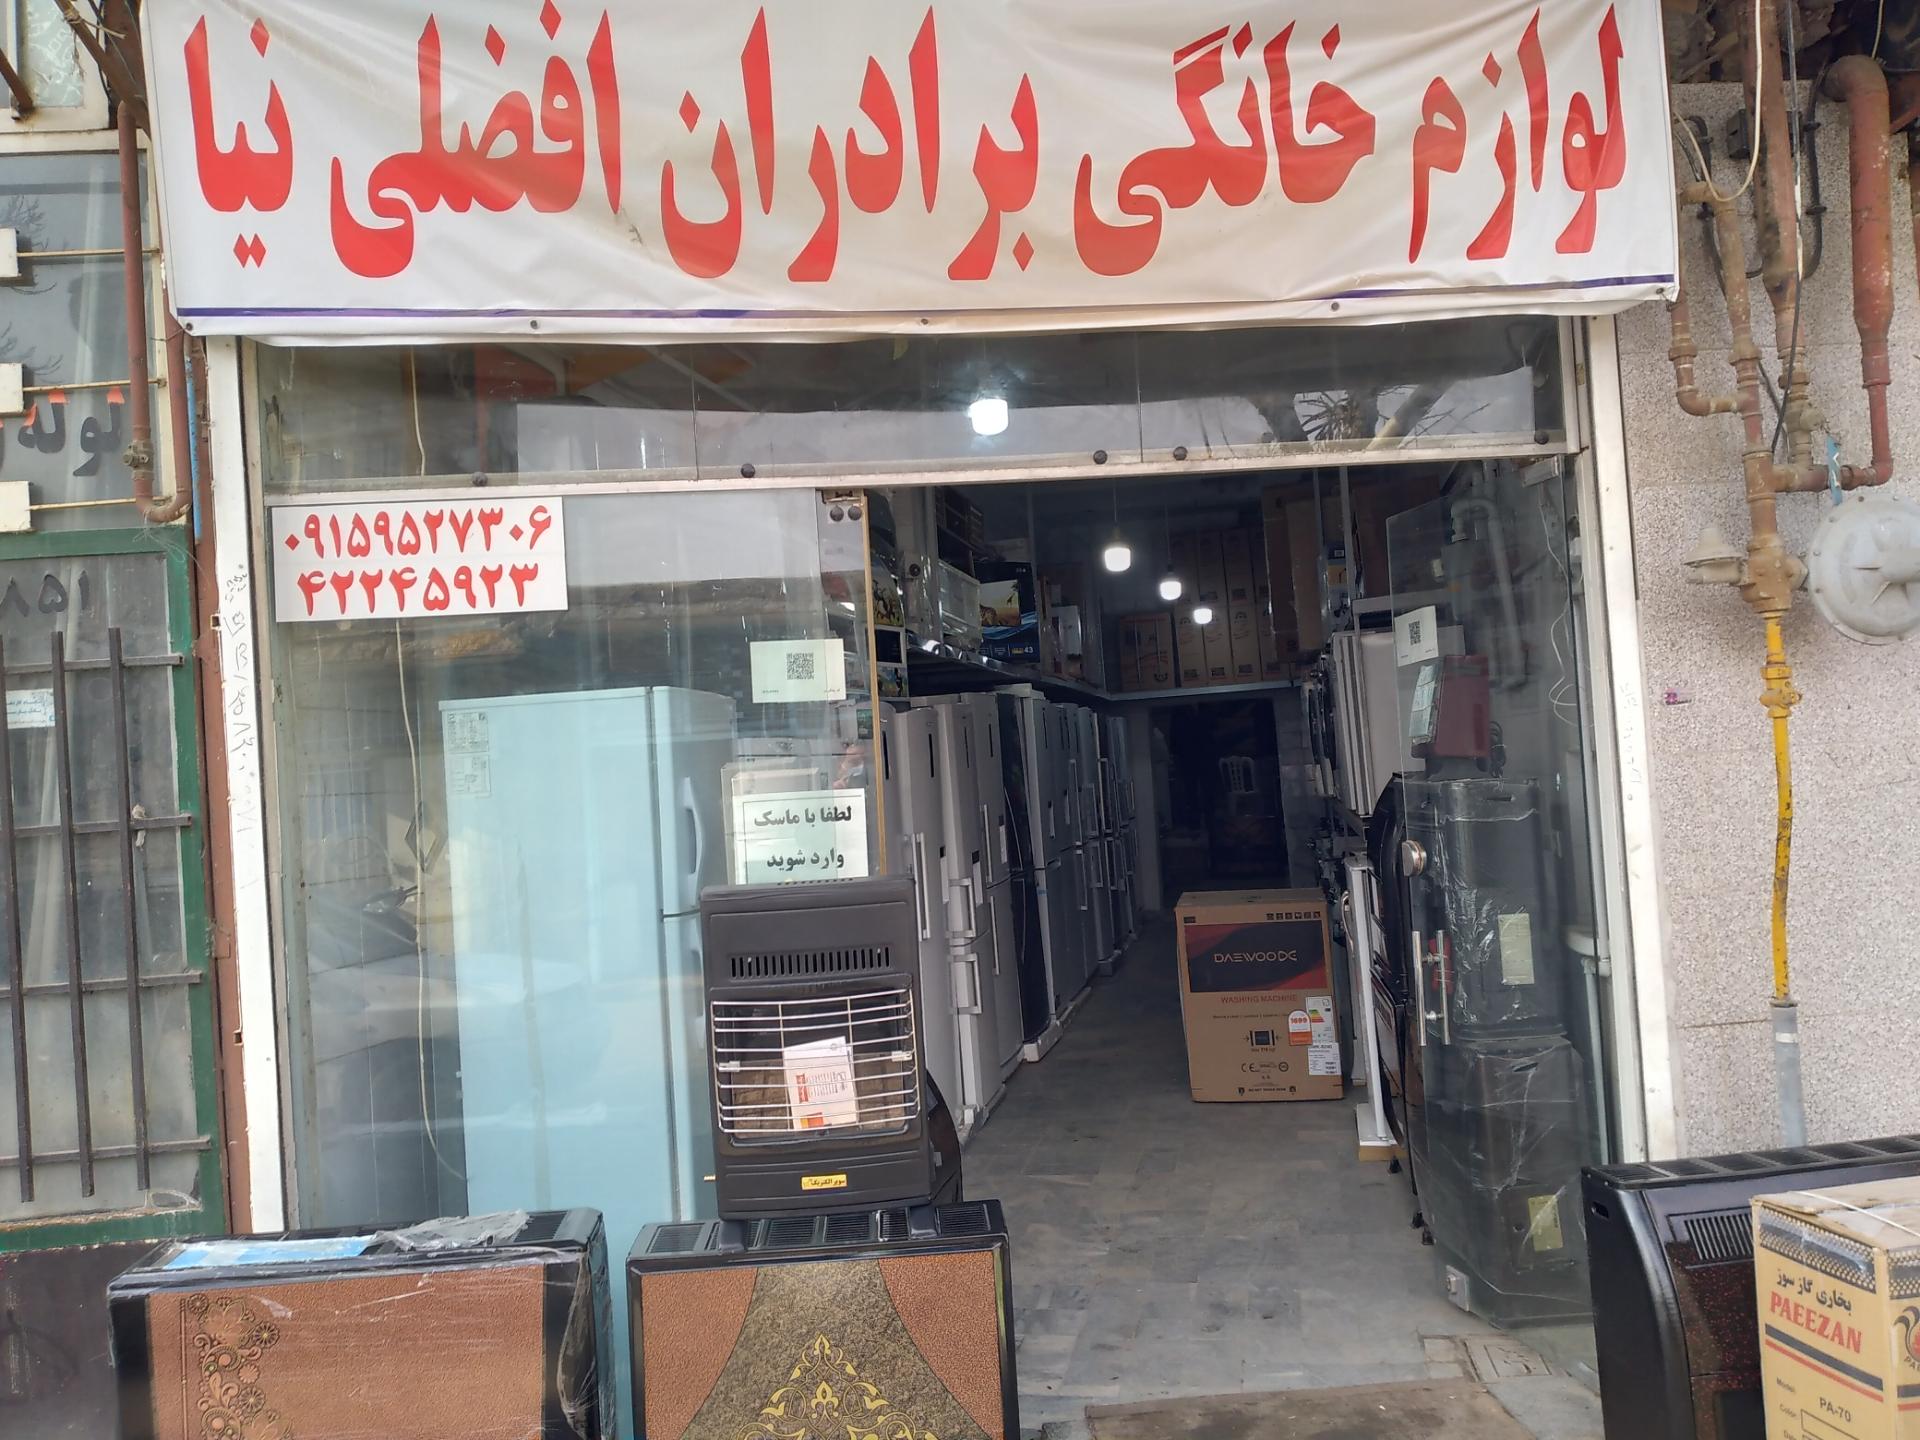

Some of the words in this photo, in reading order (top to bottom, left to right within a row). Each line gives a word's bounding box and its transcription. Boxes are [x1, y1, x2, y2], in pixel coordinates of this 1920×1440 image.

[184, 14, 293, 269] نیا
[330, 0, 622, 279] افضلی
[660, 5, 1040, 281] برادران
[1074, 20, 1376, 276] خانگی
[1408, 5, 1628, 264] لوازم
[284, 504, 552, 560] ۰۹۱۵۹۵۲۷۳۰۶
[297, 562, 539, 617] ۴۲۲۴۵۹۲۳
[754, 809, 800, 827] ماسک
[804, 808, 816, 828] با
[821, 805, 852, 822] لطفا
[767, 849, 806, 872] شوید
[810, 847, 845, 870] وارد
[1221, 995, 1259, 1004] WASHING
[1260, 993, 1298, 1003] MACHINE
[1776, 1268, 1795, 1288] سوز
[1797, 1276, 1813, 1295] گاز
[1816, 1289, 1852, 1317] بخاری
[1770, 1290, 1862, 1354] PAEEZAN
[1819, 1396, 1852, 1423] PA-70
